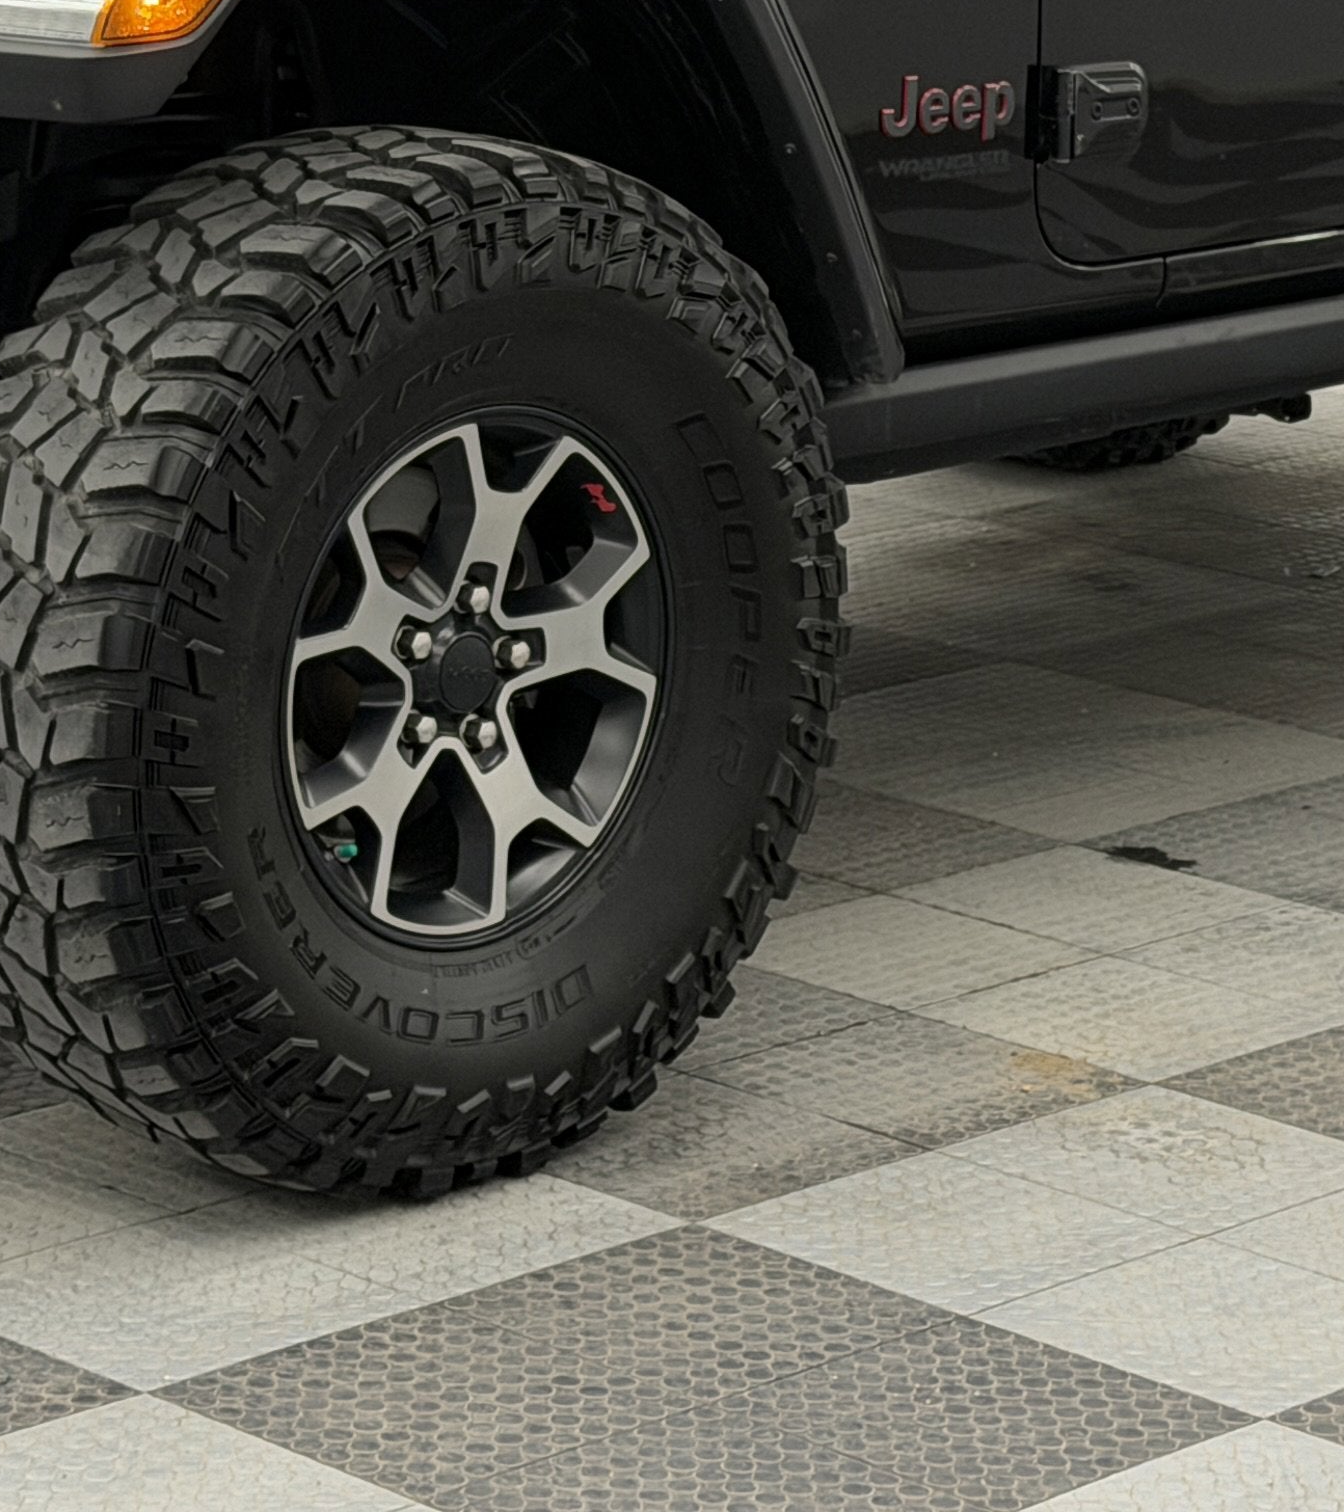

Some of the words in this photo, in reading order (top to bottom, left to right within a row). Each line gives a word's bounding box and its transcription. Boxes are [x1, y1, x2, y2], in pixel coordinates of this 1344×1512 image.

[879, 75, 1015, 143] Jeep
[670, 408, 763, 788] COOPER
[246, 821, 596, 1048] DISCOVERER
